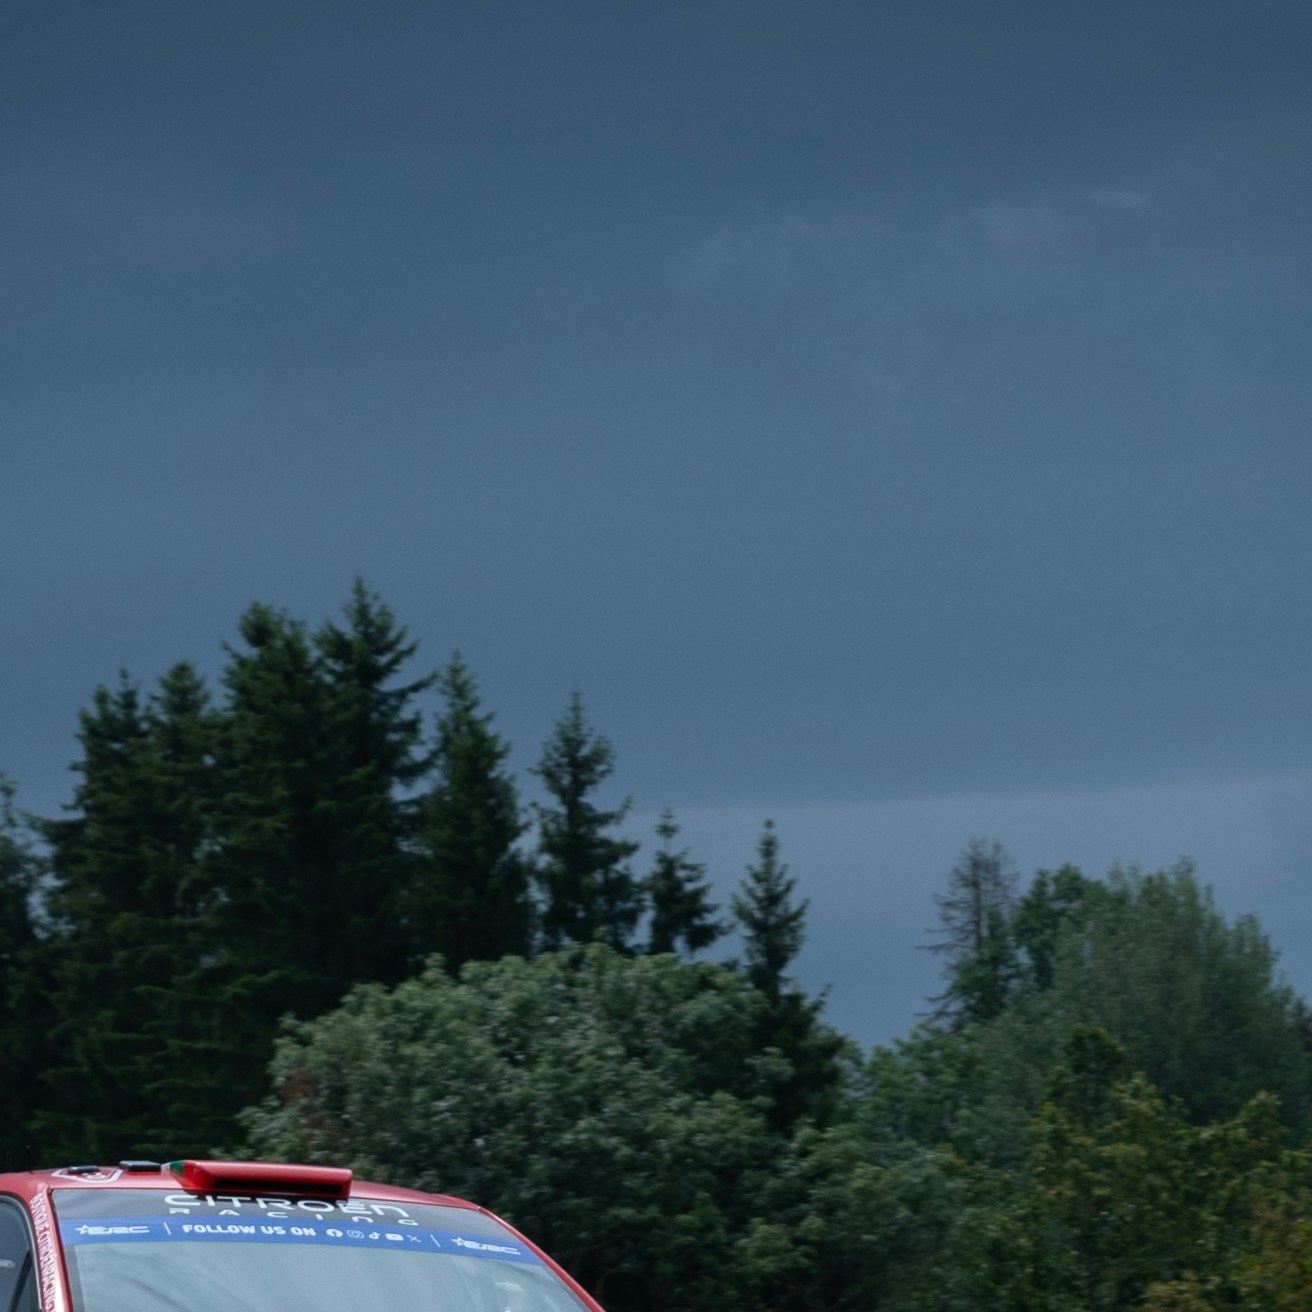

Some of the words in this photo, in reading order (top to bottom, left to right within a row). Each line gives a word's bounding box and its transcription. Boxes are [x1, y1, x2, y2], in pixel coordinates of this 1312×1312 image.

[182, 1223, 255, 1235] FOLLOW
[260, 1225, 285, 1236] US
[290, 1226, 316, 1237] ON
